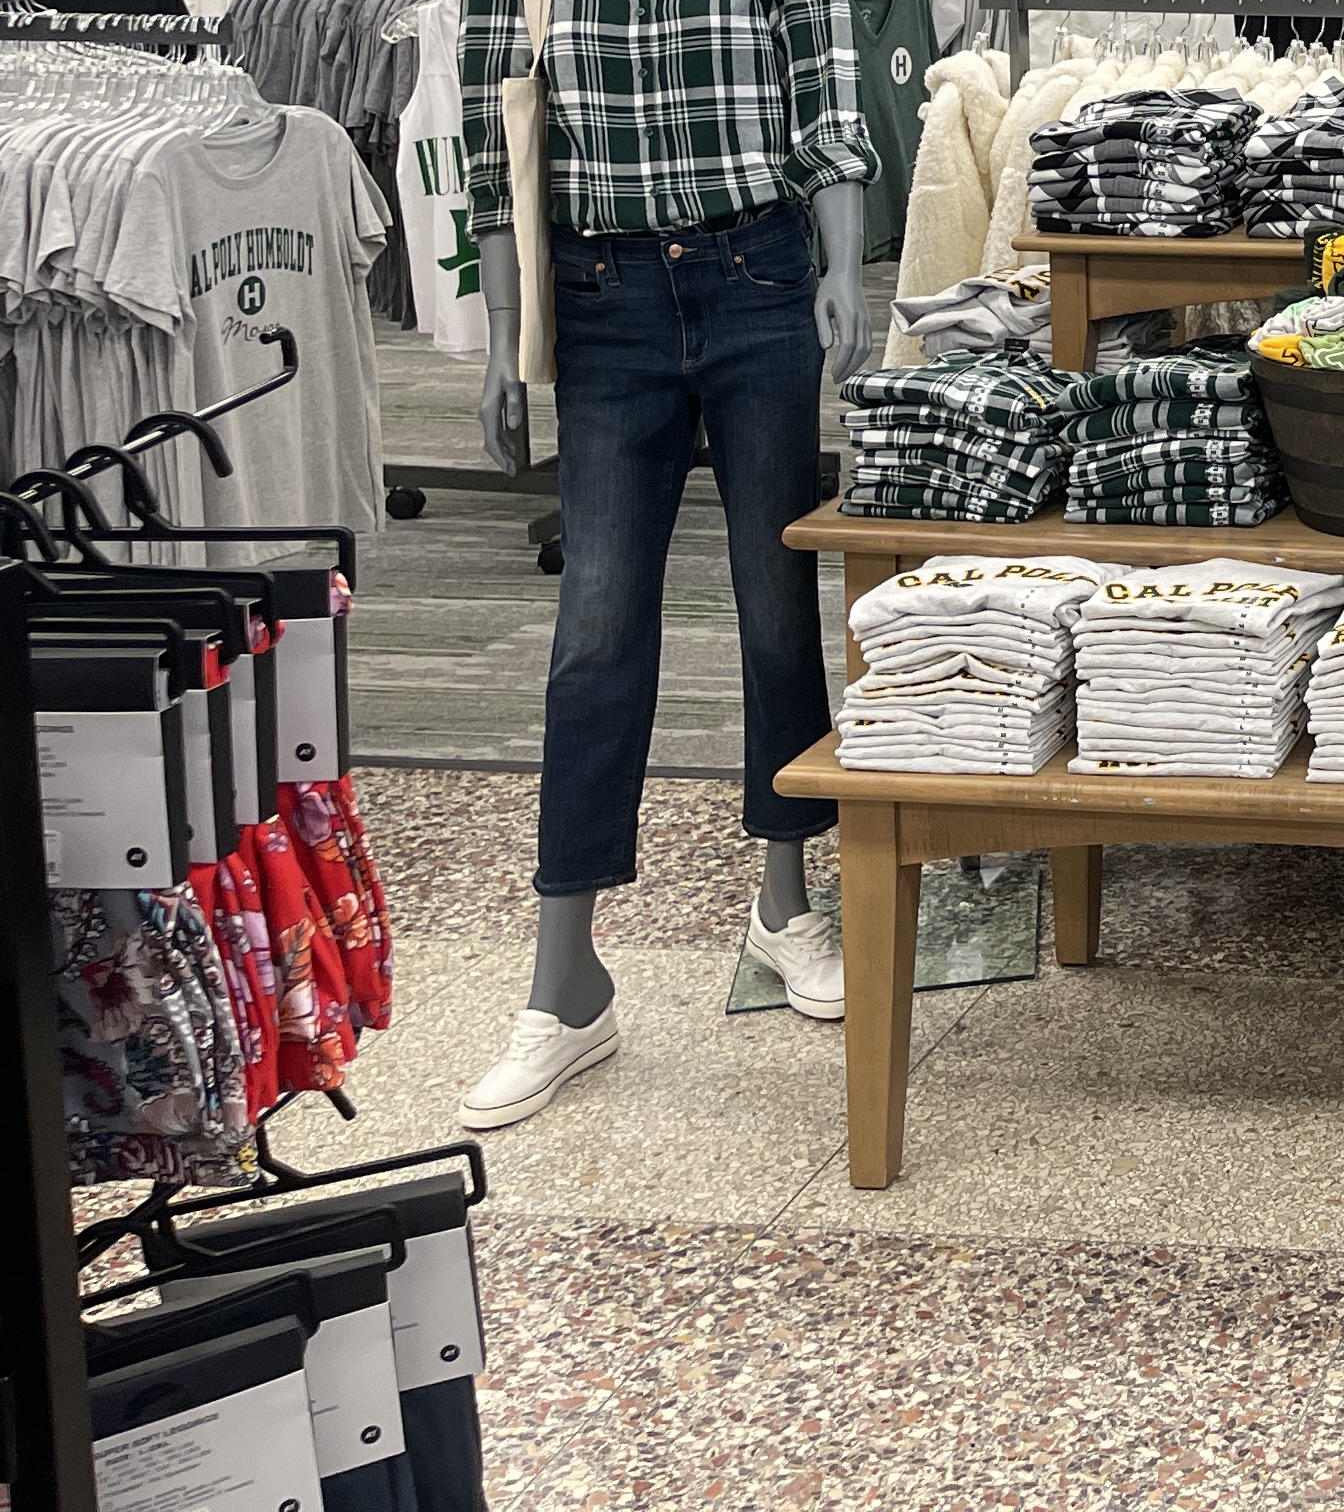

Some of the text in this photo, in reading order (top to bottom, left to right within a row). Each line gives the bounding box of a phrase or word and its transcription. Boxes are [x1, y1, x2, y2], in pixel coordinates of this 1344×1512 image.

[191, 226, 315, 299] AL POLY HUMBOLDT
[242, 281, 262, 310] H
[896, 567, 985, 589] CAL
[1105, 583, 1193, 600] CAL
